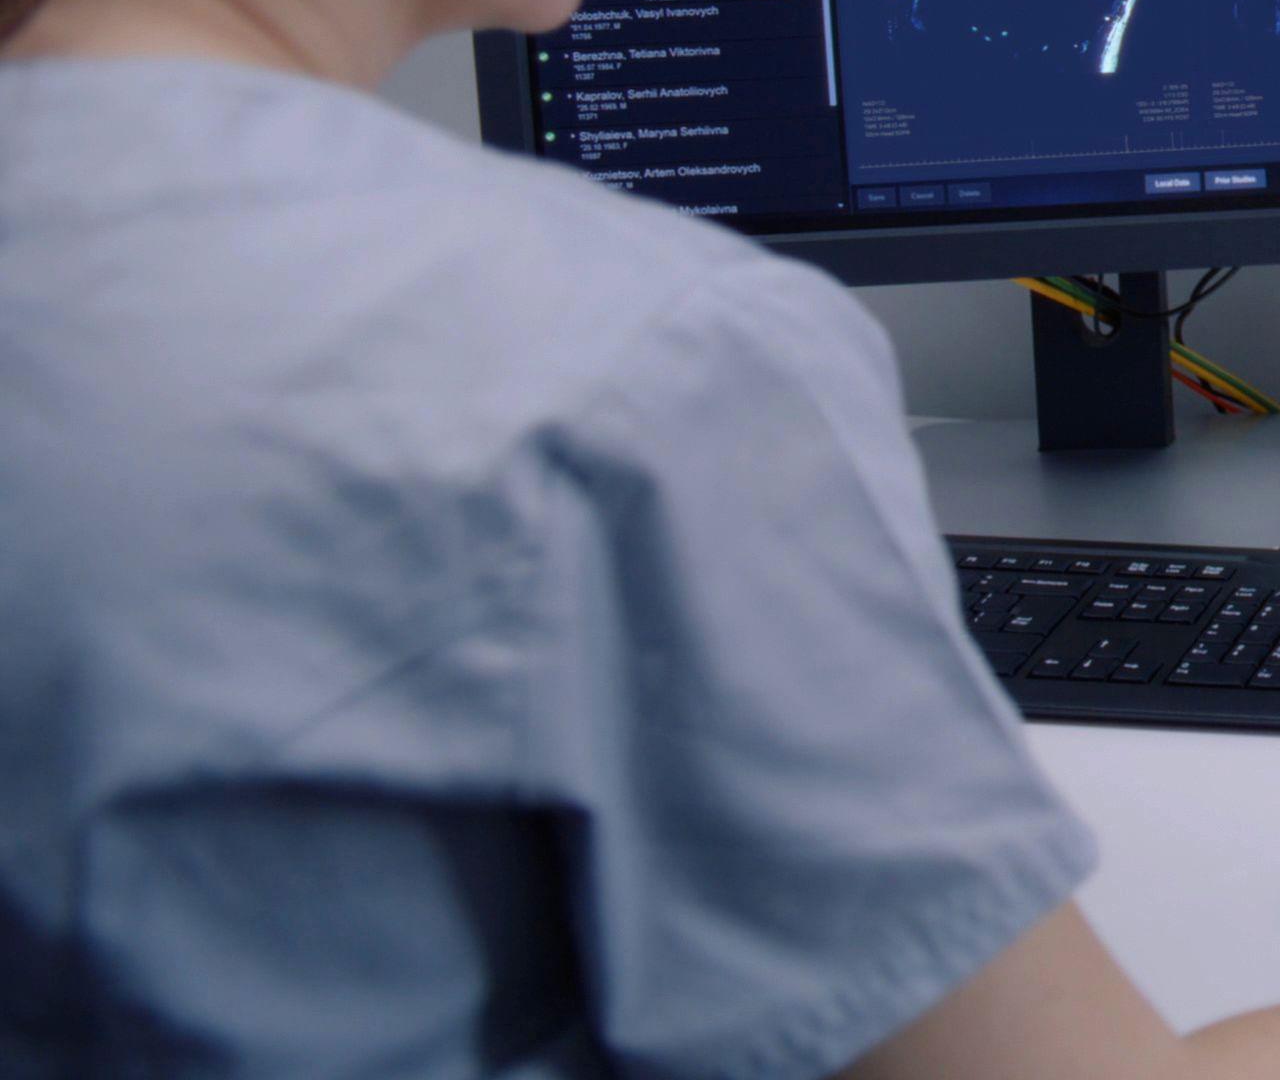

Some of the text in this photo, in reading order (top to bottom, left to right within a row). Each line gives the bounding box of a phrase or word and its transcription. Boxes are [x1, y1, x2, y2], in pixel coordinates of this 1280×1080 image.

[635, 7, 664, 20] Vasyl
[666, 6, 719, 18] Ivanovych
[573, 46, 721, 62] Berezhna, Tetiana Viktorivna
[576, 90, 625, 102] Kapralov,
[627, 89, 658, 100] Serhii
[638, 128, 678, 141] Maryna
[680, 126, 729, 137] Serhiivna
[644, 167, 676, 179] Artem
[677, 163, 761, 177] Oleksandrovych
[679, 203, 738, 216] Mykolaivna
